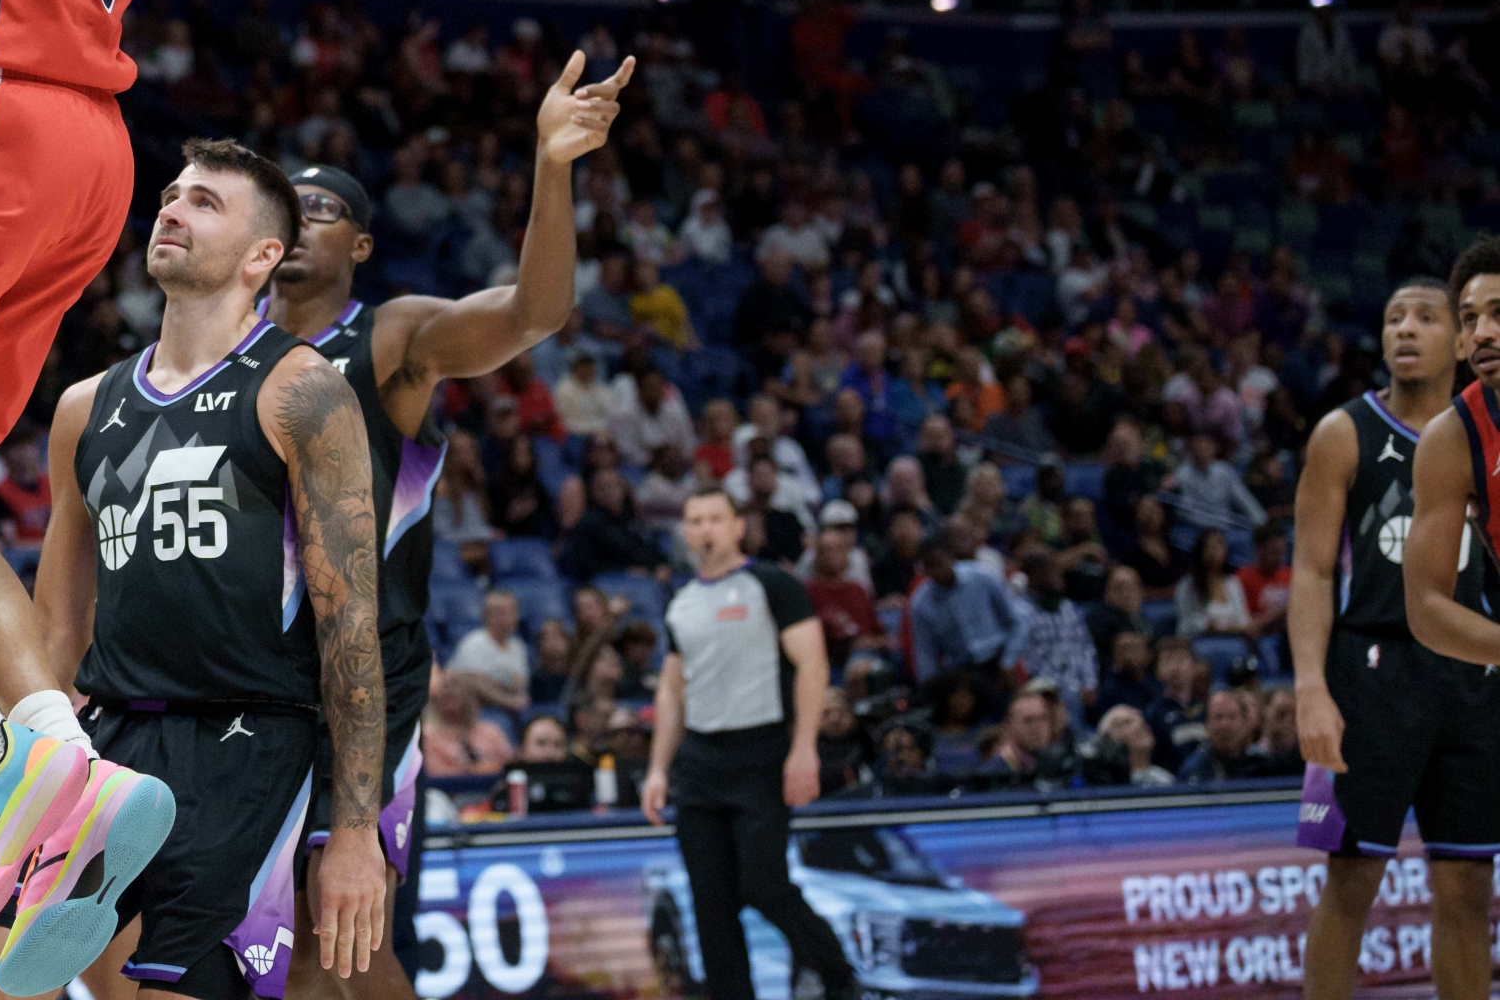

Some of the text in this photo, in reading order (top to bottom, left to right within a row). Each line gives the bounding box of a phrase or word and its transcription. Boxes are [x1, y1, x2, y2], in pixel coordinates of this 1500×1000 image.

[153, 487, 228, 561] 55
[1122, 869, 1253, 923] PROUD
[1256, 857, 1432, 916] SPOOR
[1133, 939, 1220, 993] NEW
